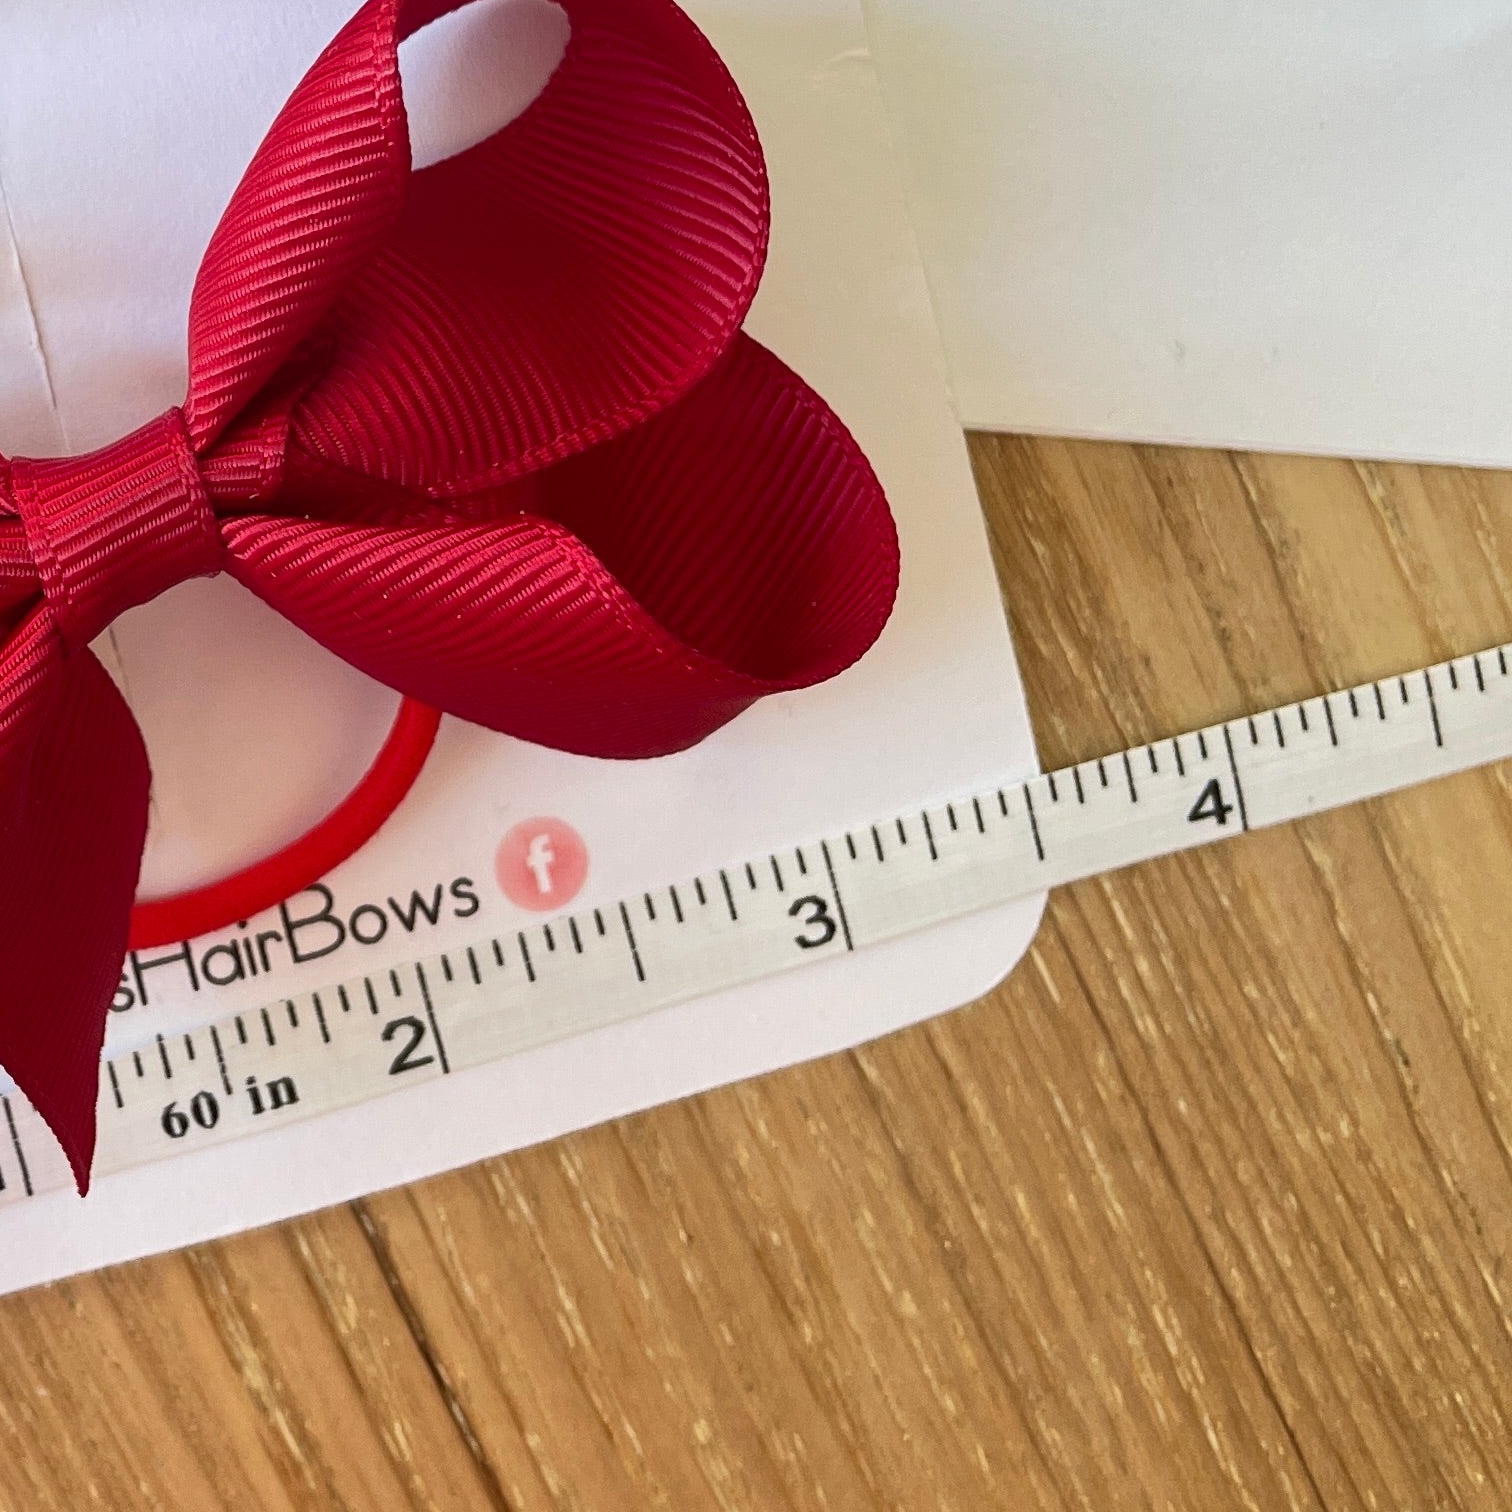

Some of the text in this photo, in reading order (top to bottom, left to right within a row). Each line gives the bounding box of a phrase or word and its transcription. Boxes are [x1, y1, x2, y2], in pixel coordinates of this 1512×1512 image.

[1188, 778, 1234, 827] 4
[787, 894, 837, 950] 3
[381, 1015, 434, 1076] 2
[160, 1075, 300, 1139] 60 in
